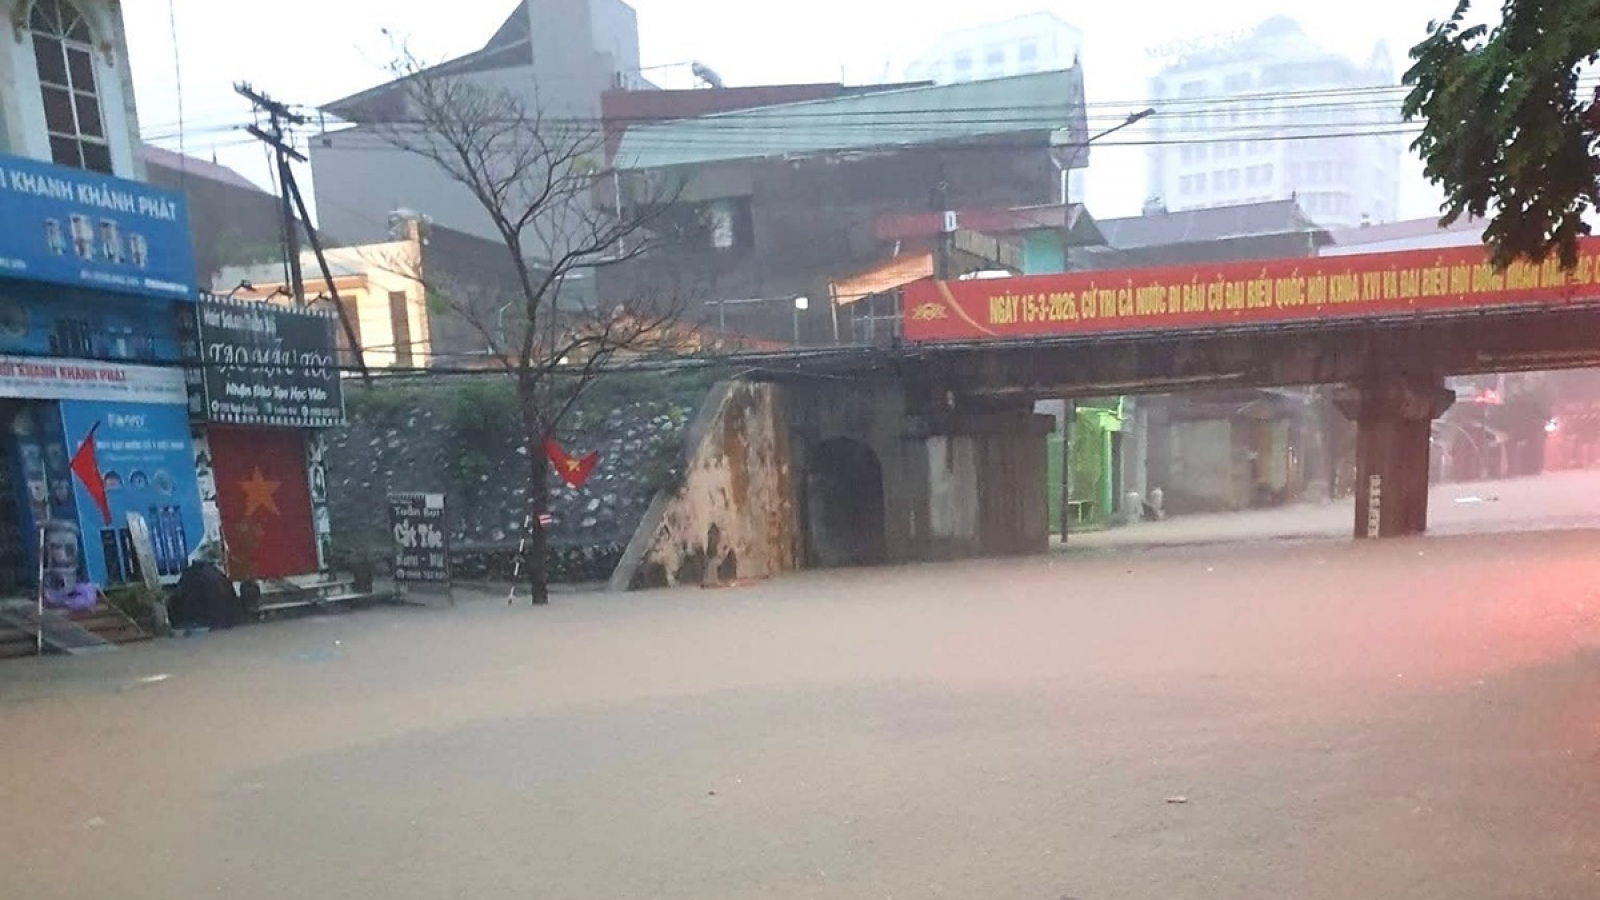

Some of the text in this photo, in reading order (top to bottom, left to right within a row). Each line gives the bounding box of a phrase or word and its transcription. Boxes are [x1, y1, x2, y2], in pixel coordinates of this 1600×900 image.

[10, 170, 74, 200] KHANH
[77, 182, 135, 213] KHÁNH
[138, 196, 176, 220] PHÁT
[990, 290, 1019, 324] NGÀY
[1021, 292, 1079, 323] 15-3-2026,
[1099, 289, 1117, 318] TRI
[1119, 278, 1133, 317] CẢ
[1136, 280, 1167, 315] NƯỚC
[1275, 267, 1305, 310] QUỐC
[1307, 270, 1327, 311] HỘI
[1362, 271, 1380, 300] XVI
